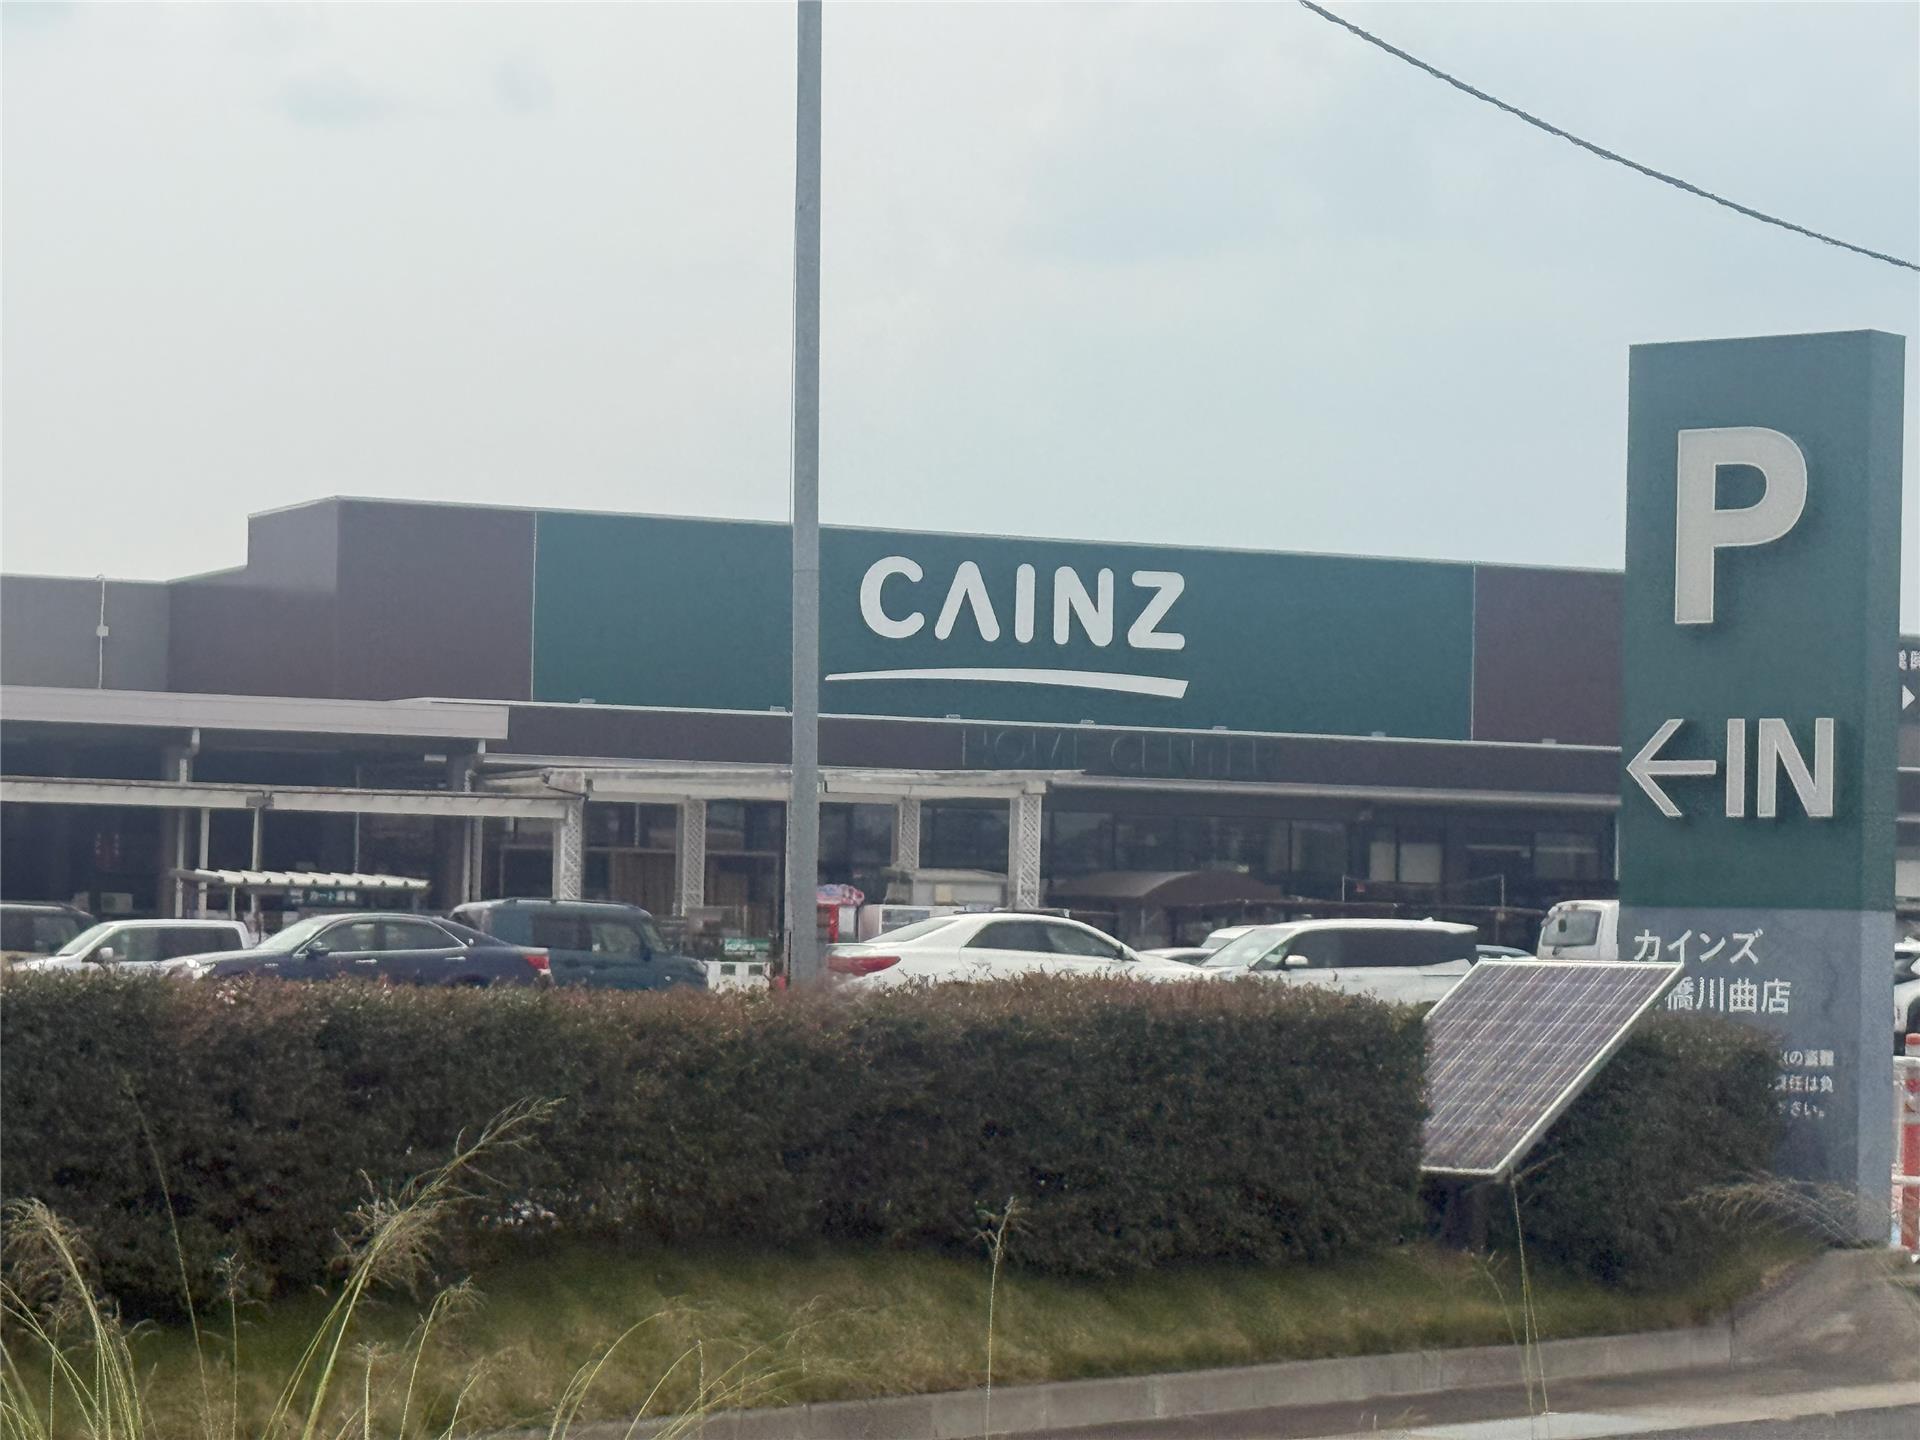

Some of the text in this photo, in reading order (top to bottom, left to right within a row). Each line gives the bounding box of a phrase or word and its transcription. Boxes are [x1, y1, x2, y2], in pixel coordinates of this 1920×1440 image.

[1675, 426, 1808, 624] P
[859, 556, 1186, 650] CAINZ
[1725, 717, 1834, 817] IN
[1633, 928, 1764, 965] カインズ
[1662, 976, 1792, 1015] 橋川曲店
